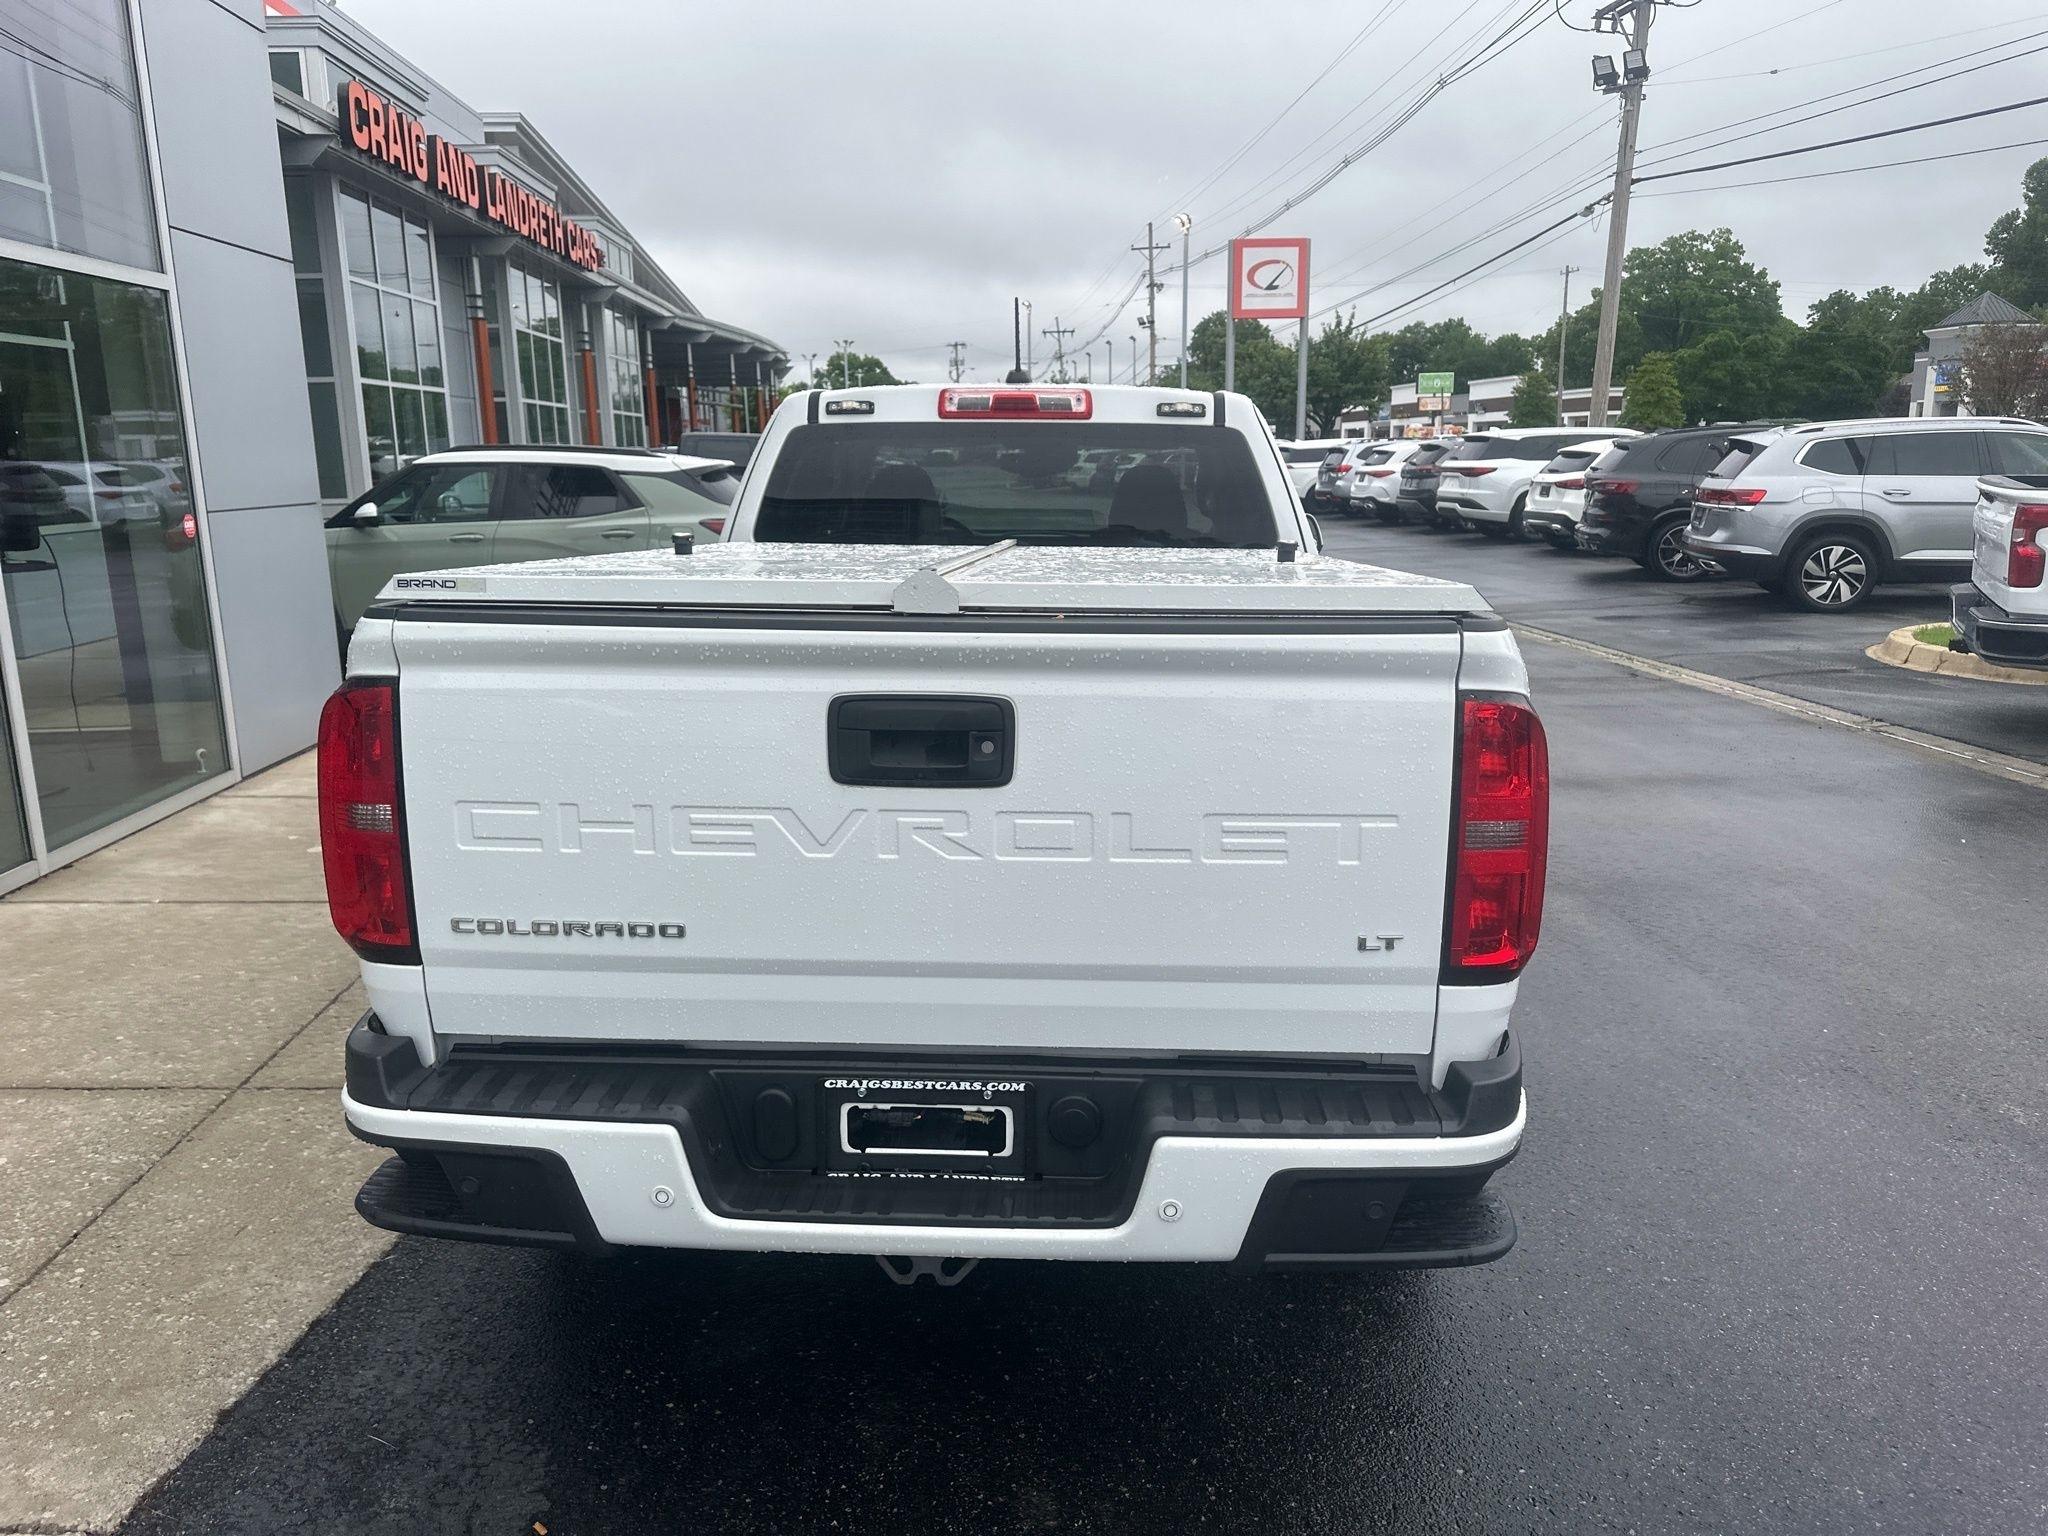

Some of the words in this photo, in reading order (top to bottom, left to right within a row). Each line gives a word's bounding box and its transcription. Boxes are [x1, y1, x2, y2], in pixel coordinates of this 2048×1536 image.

[347, 80, 428, 183] CRAIG
[436, 135, 480, 210] AND
[484, 166, 564, 255] LANDRETH
[567, 219, 598, 273] CARS
[396, 579, 456, 589] BRAND
[454, 800, 1399, 866] CHEVROLET
[450, 917, 687, 939] COLORADO
[1357, 934, 1404, 951] LT
[824, 1079, 1025, 1091] CRAIGSBESTCARS.COM
